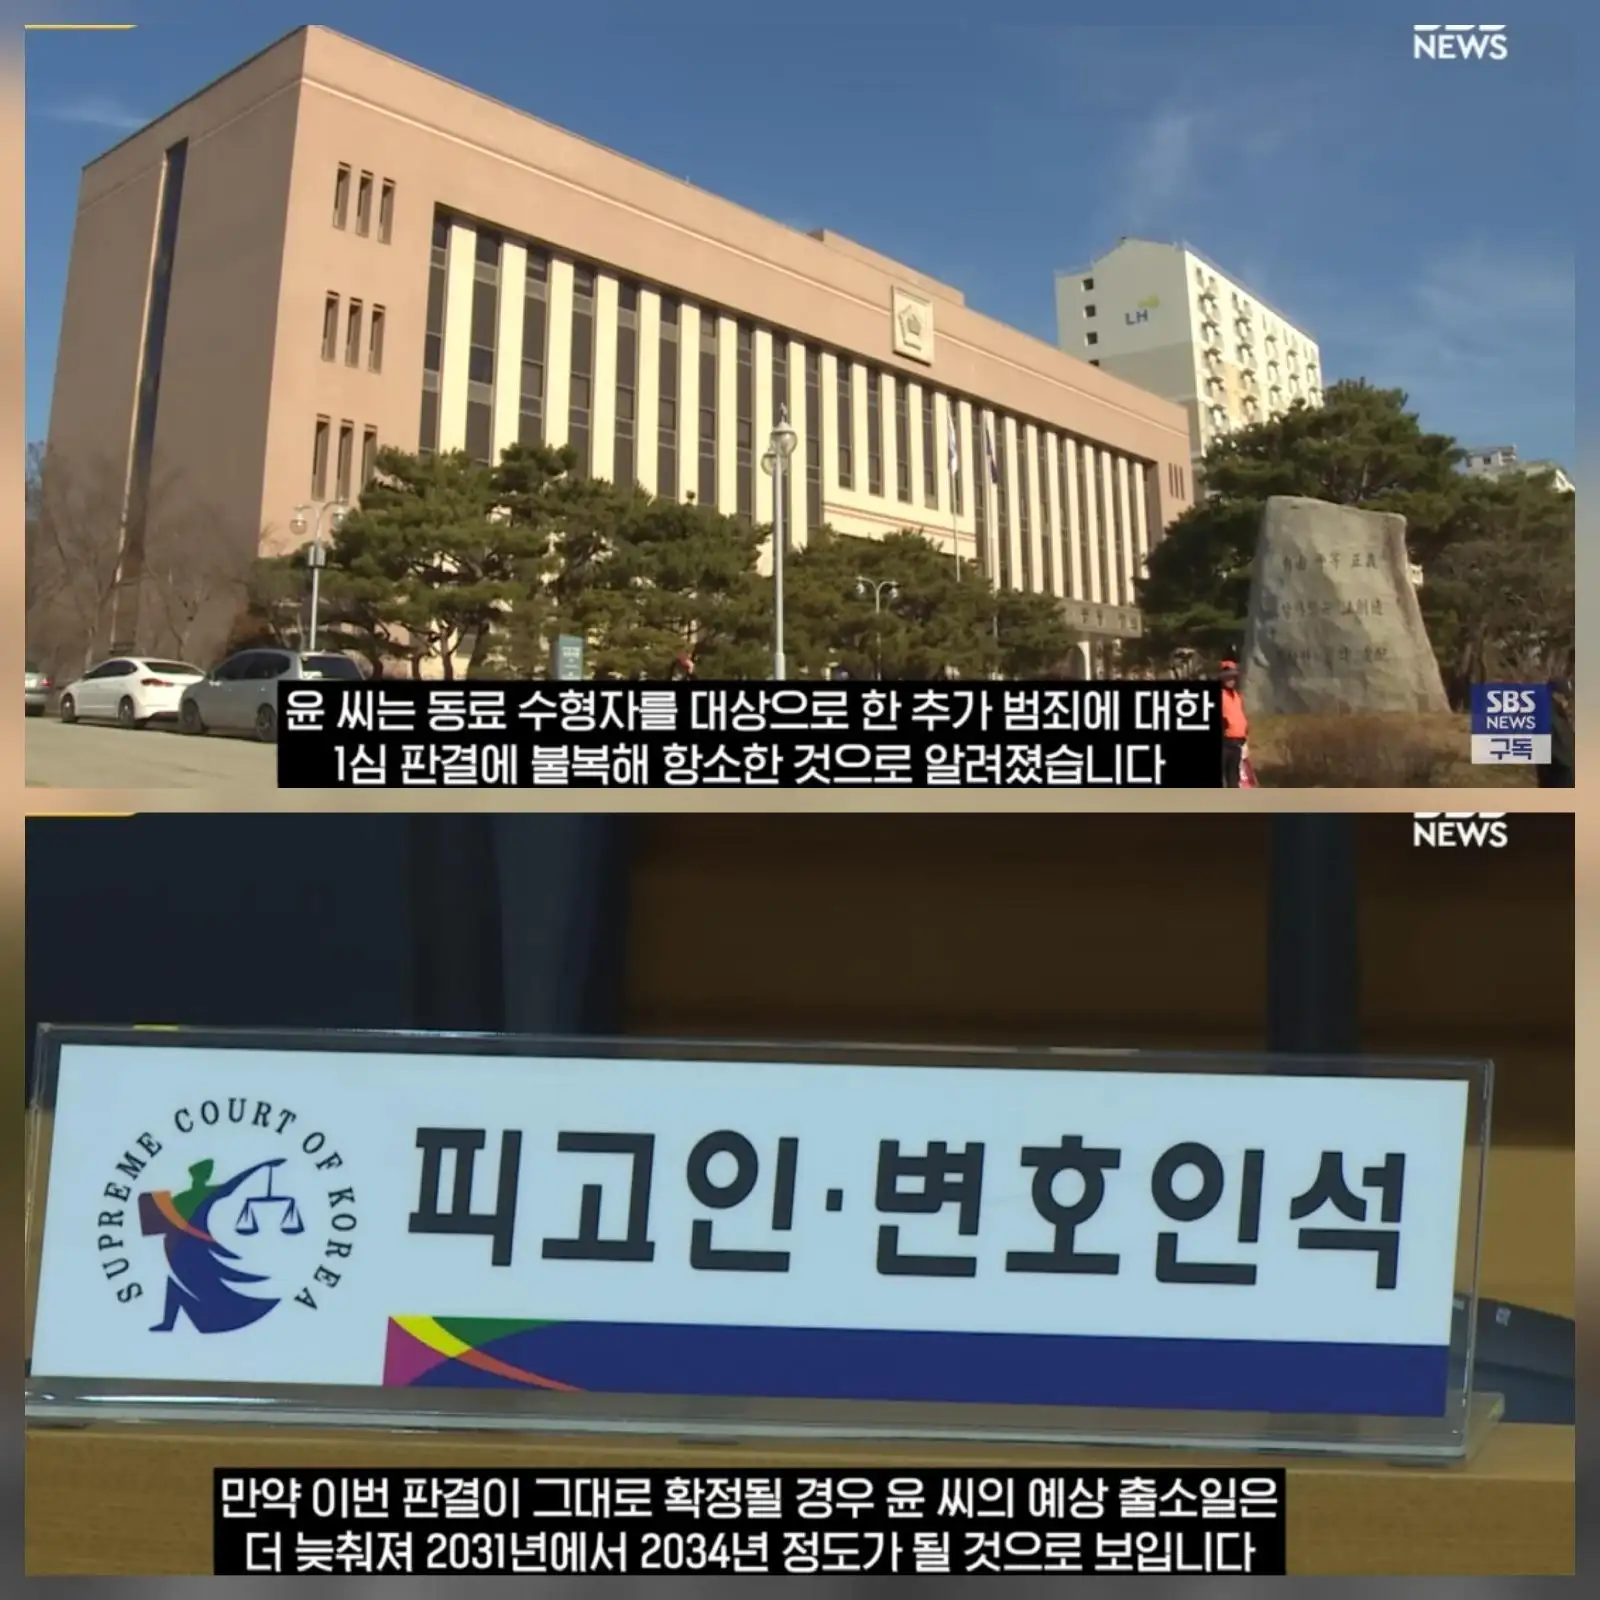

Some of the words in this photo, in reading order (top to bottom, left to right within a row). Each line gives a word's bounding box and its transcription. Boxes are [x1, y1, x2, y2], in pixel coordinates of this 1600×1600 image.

[1124, 309, 1149, 326] LH
[174, 1098, 297, 1134] COURT
[302, 1131, 344, 1171] OF
[98, 1132, 163, 1304] SUPREME
[294, 1186, 358, 1312] KOREA
